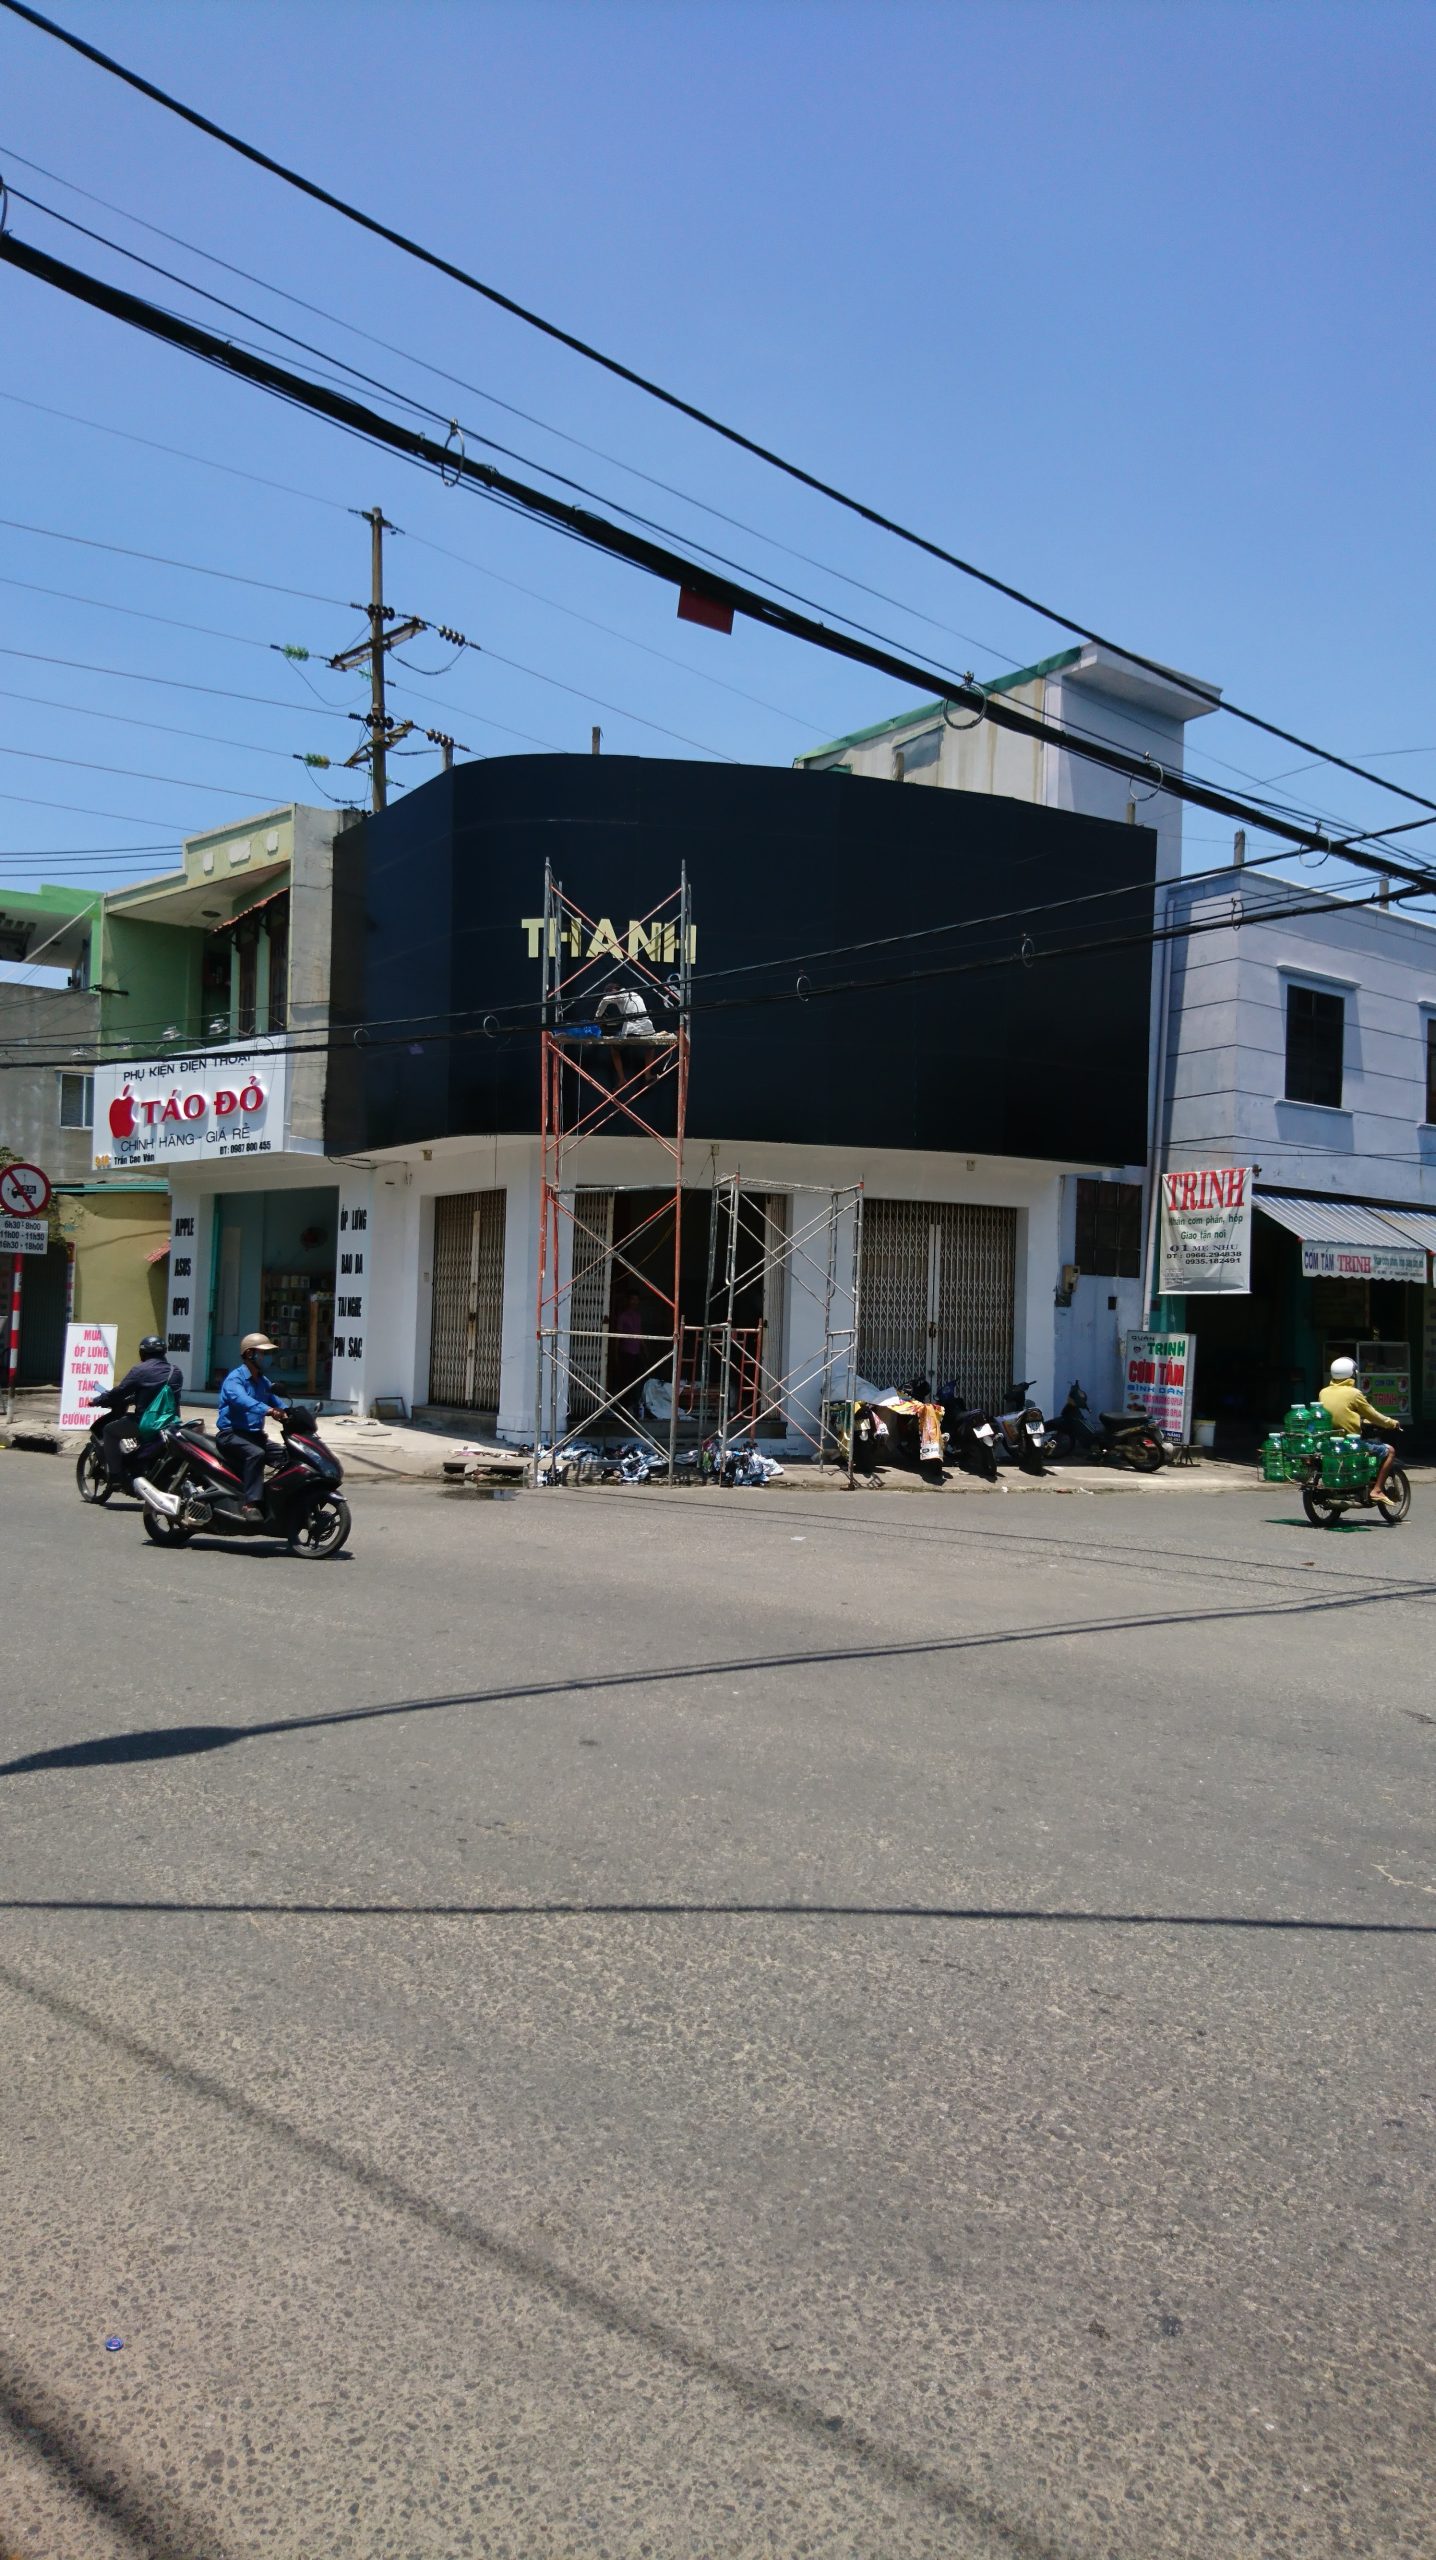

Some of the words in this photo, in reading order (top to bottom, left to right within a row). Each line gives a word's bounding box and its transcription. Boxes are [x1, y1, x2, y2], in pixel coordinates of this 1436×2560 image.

[521, 918, 697, 965] THANH
[124, 1068, 145, 1082] PHỤ
[149, 1064, 175, 1078] KIỆN
[180, 1058, 206, 1073] ĐIỆN
[141, 1089, 206, 1124] TÁO
[214, 1076, 264, 1116] ĐỎ
[121, 1138, 154, 1152] CHÍNH
[159, 1131, 195, 1147] HÀNG
[206, 1127, 226, 1143] GIÁ
[233, 1123, 251, 1139] RẺ
[1167, 1168, 1246, 1211] TRINH
[1181, 1231, 1197, 1240] Giao
[355, 1254, 363, 1274] DA
[1337, 1255, 1371, 1273] TRINH
[84, 1330, 102, 1340] MUA
[1147, 1340, 1185, 1357] TRINH
[94, 1364, 109, 1375] 70K
[1129, 1359, 1155, 1384] CƠM
